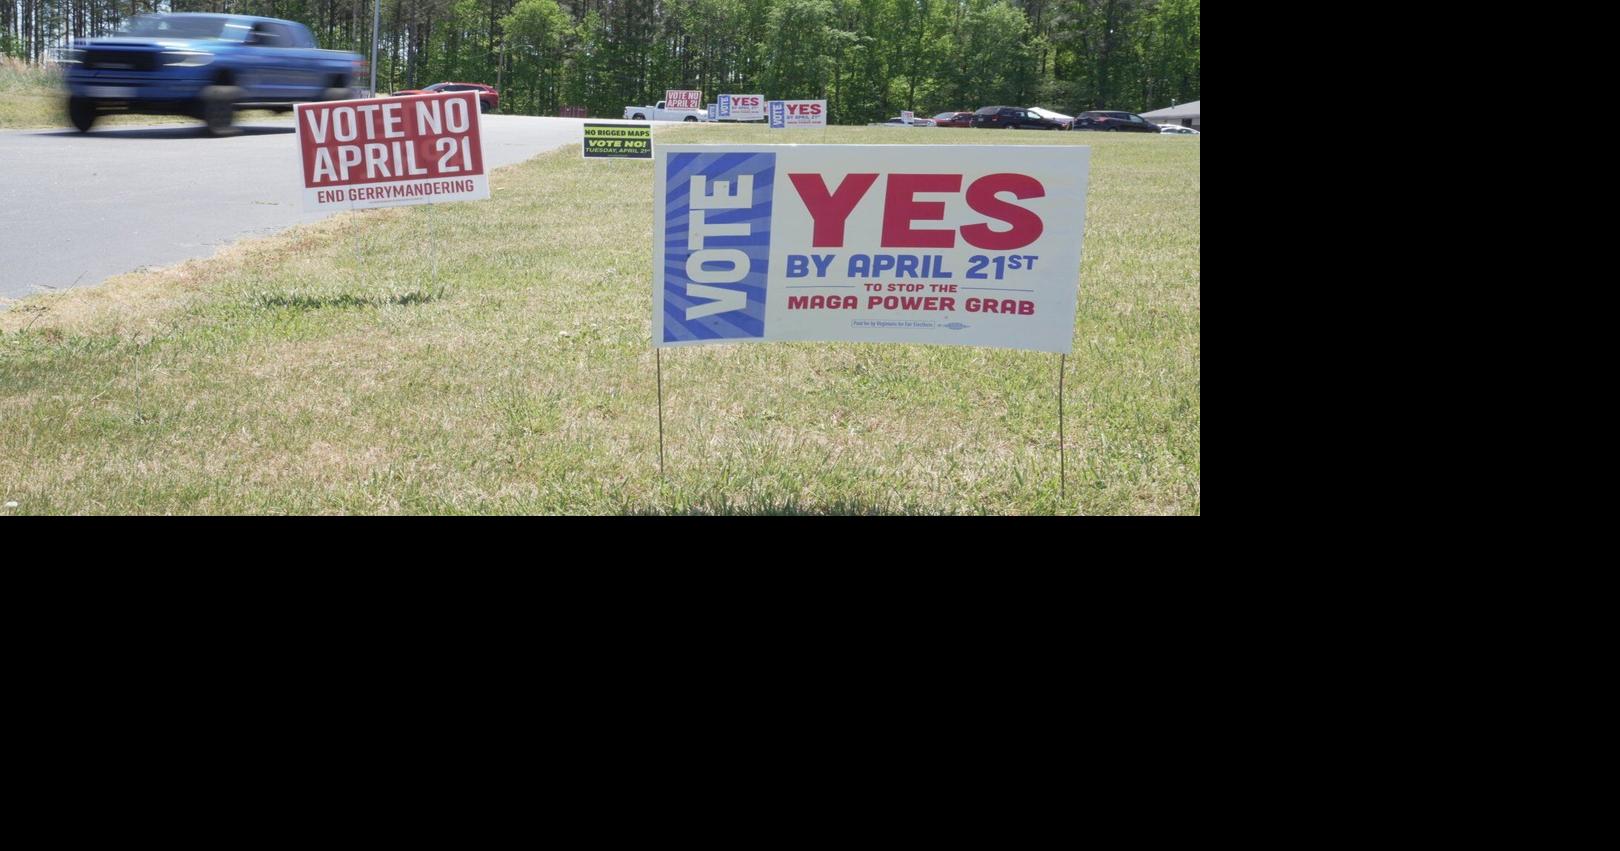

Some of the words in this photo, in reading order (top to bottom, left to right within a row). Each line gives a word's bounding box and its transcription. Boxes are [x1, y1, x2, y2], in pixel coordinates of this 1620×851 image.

[667, 99, 689, 108] APRIL
[689, 99, 698, 108] 21
[668, 91, 687, 99] VOTE
[688, 91, 699, 100] NO
[732, 97, 759, 106] YES
[772, 104, 782, 126] VOTE
[786, 103, 821, 115] YES
[305, 102, 405, 144] VOTE
[415, 97, 470, 136] NO
[624, 140, 647, 148] NO!
[312, 140, 428, 183] APRIL
[435, 135, 473, 173] 21
[317, 189, 345, 204] END
[348, 179, 474, 201] GERRYMANDERING
[788, 172, 1046, 251] YES
[685, 174, 754, 322] VOTE
[785, 254, 836, 278] BY
[847, 254, 953, 279] APRIL
[966, 254, 1039, 280] 21ST
[864, 282, 884, 292] TO
[888, 283, 925, 293] STOP
[929, 283, 958, 293] THE
[787, 294, 858, 310] MAGA
[867, 295, 956, 312] POWER
[964, 297, 1035, 316] GRAB
